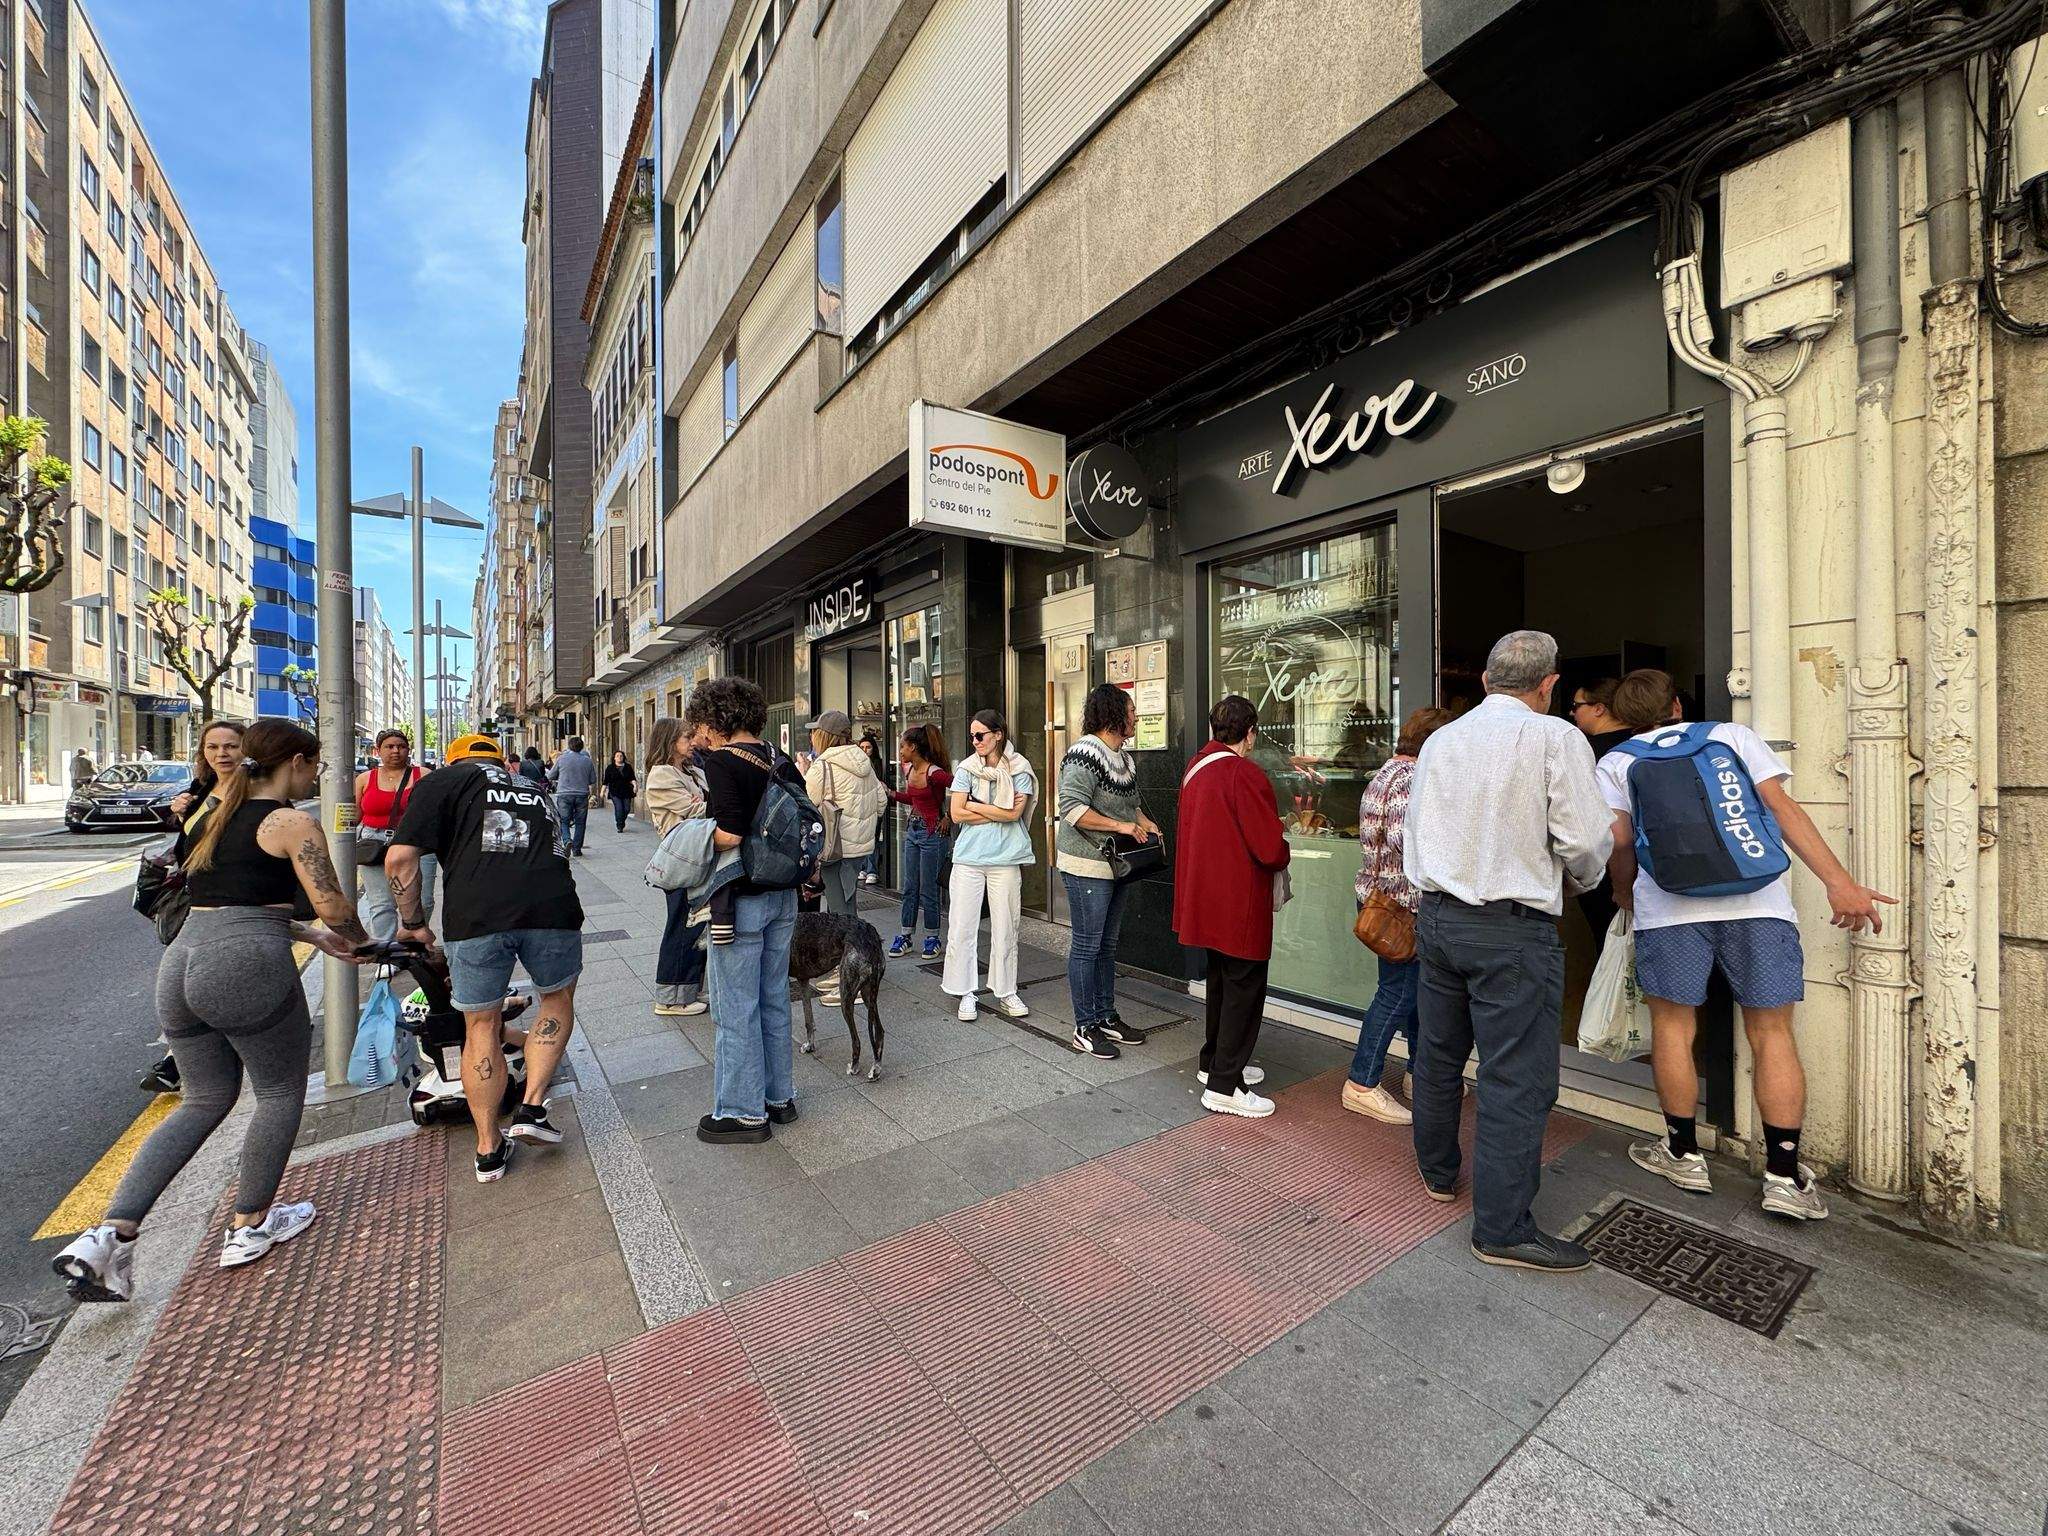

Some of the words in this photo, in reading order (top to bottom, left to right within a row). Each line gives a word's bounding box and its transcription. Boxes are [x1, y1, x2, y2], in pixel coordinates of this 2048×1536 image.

[1466, 355, 1527, 393] SANO
[1272, 378, 1438, 494] Xeve
[929, 452, 1025, 486] podospont
[1238, 452, 1273, 479] ARTE
[929, 472, 960, 489] Centro
[962, 481, 975, 493] del
[978, 483, 992, 495] Pie
[1089, 467, 1143, 507] Xeve
[940, 500, 956, 512] 692
[958, 503, 973, 515] 601
[976, 507, 991, 518] 112
[809, 579, 865, 635] INSIDE
[1065, 650, 1077, 669] 38
[486, 789, 546, 809] NASA
[1718, 770, 1765, 858] adidas
